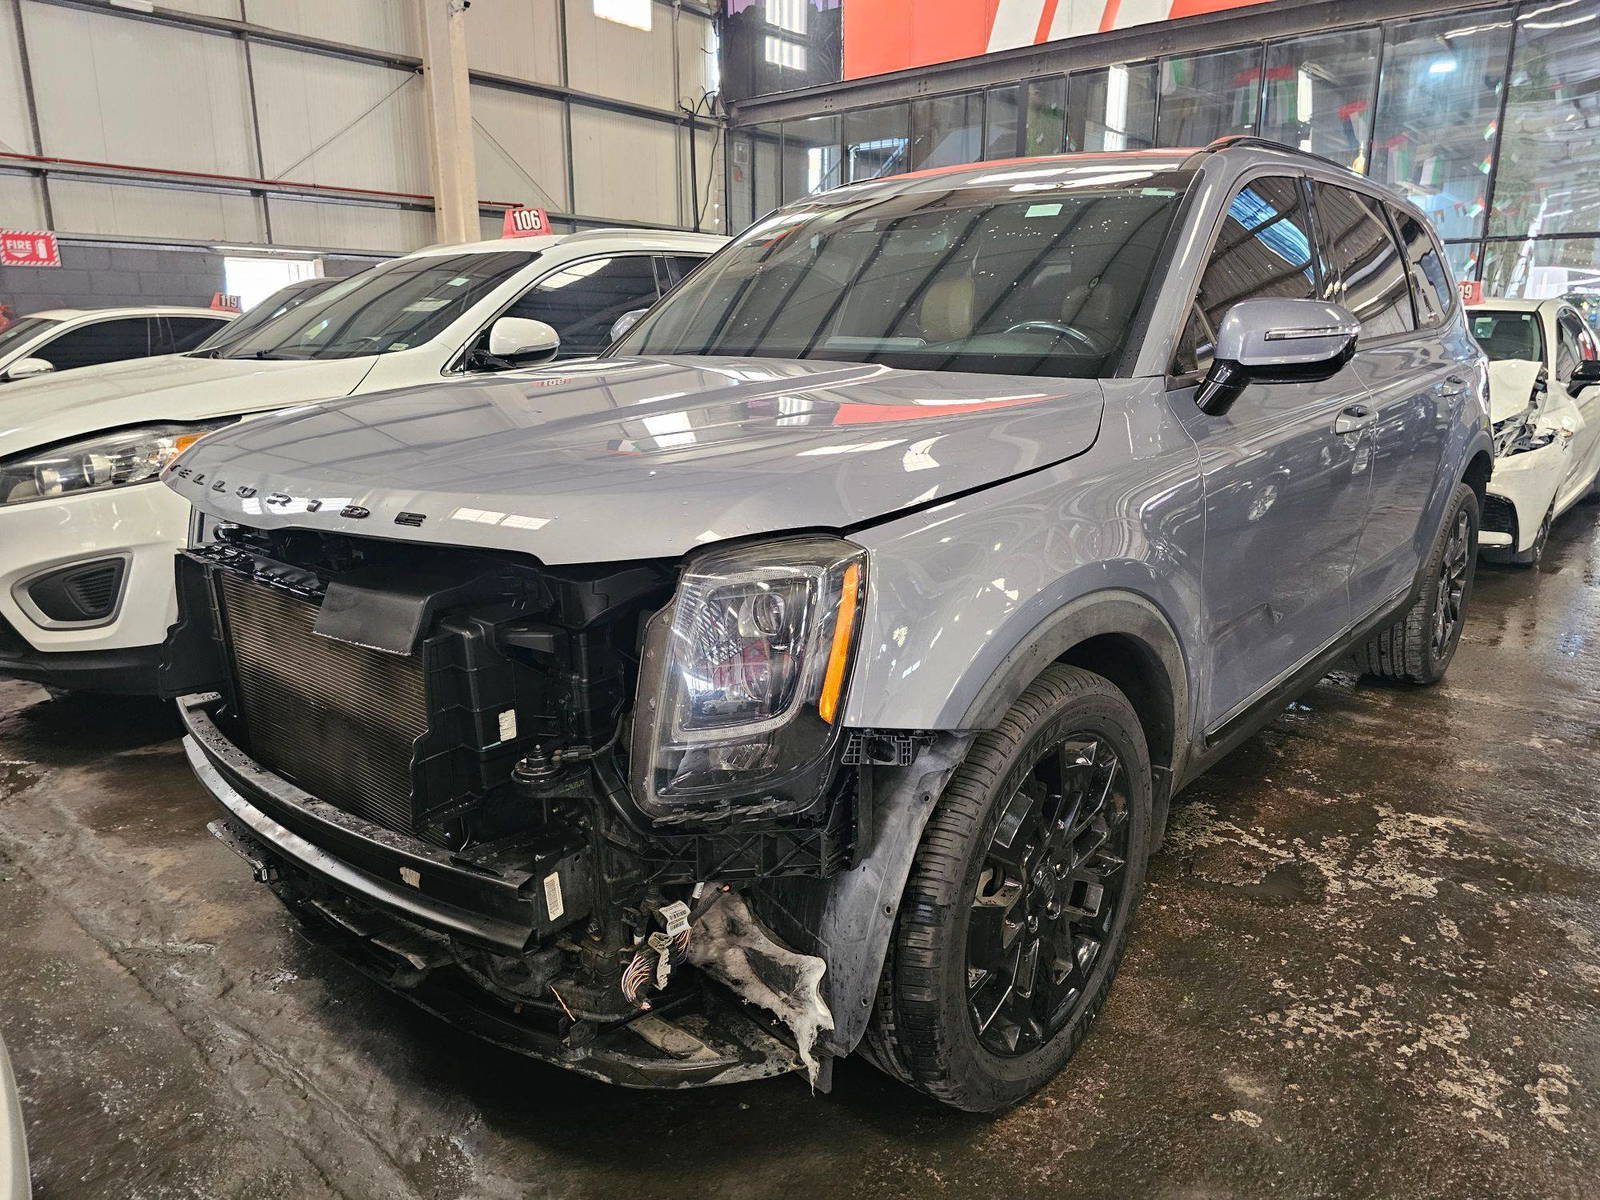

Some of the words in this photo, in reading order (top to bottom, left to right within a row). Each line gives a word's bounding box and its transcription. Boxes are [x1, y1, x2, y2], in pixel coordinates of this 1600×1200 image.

[513, 210, 541, 231] 106
[6, 240, 32, 250] FIRE
[221, 295, 237, 308] 119
